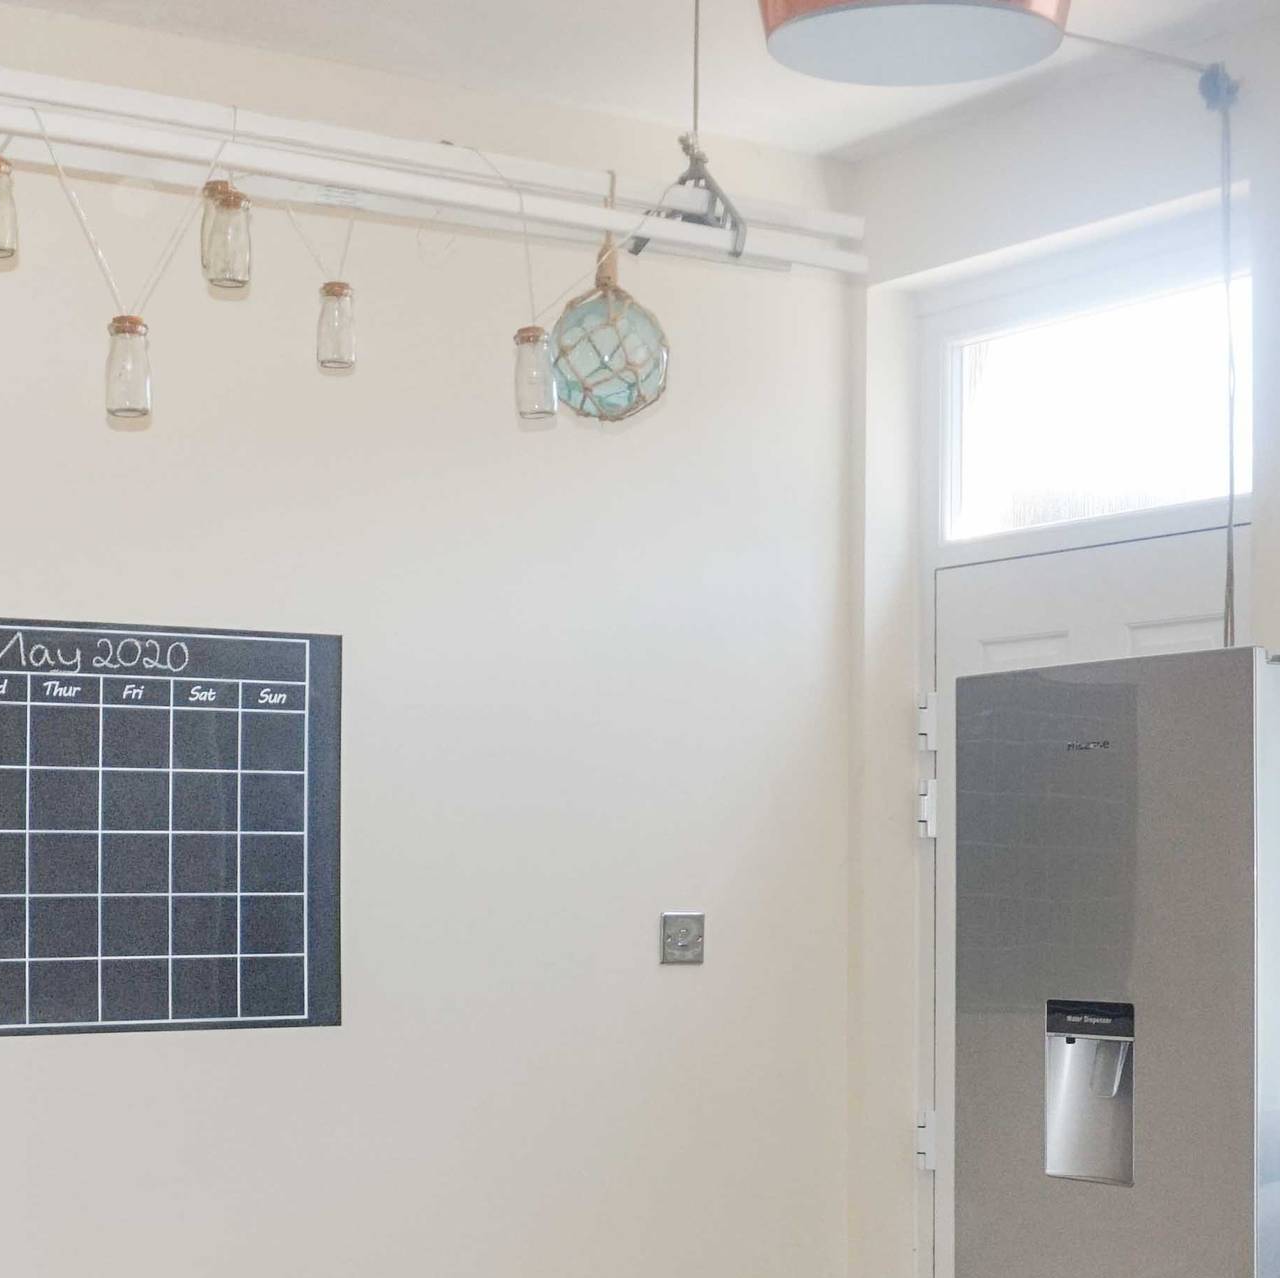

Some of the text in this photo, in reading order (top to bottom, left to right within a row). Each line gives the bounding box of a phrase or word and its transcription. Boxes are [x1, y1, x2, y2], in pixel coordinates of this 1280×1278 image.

[93, 638, 189, 672] 2020
[43, 681, 81, 698] Thur
[123, 685, 145, 700] Fri
[188, 686, 216, 702] Sat
[257, 688, 287, 704] Sun
